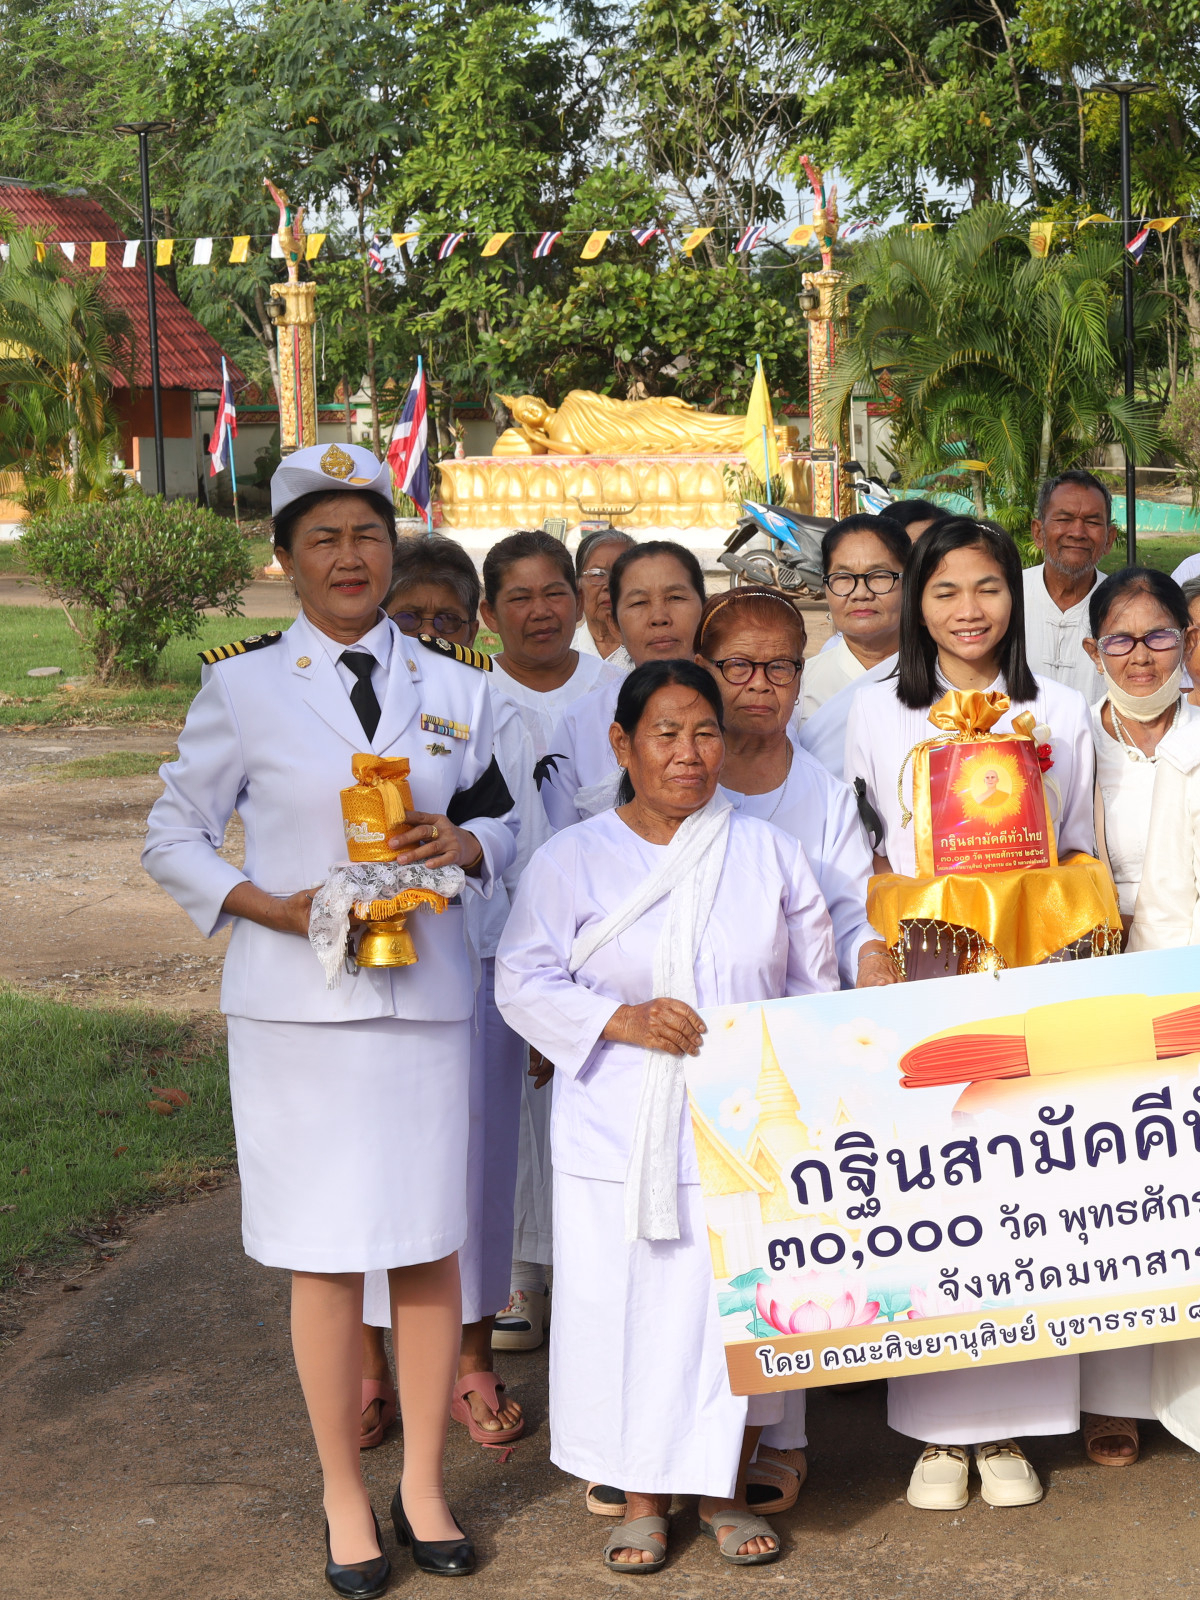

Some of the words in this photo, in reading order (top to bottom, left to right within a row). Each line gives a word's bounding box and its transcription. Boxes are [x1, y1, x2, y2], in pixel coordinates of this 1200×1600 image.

[940, 826, 1042, 851] กฐินสามัคคีทั่วไทย
[972, 852, 983, 860] วัด
[767, 1214, 983, 1271] ๓๐,๐๐๐
[999, 1203, 1047, 1240] วัด
[759, 1348, 811, 1374] โดย
[823, 1314, 1036, 1367] คณะศิษยานุศิษย์
[1048, 1305, 1176, 1346] บูชาธรรม
